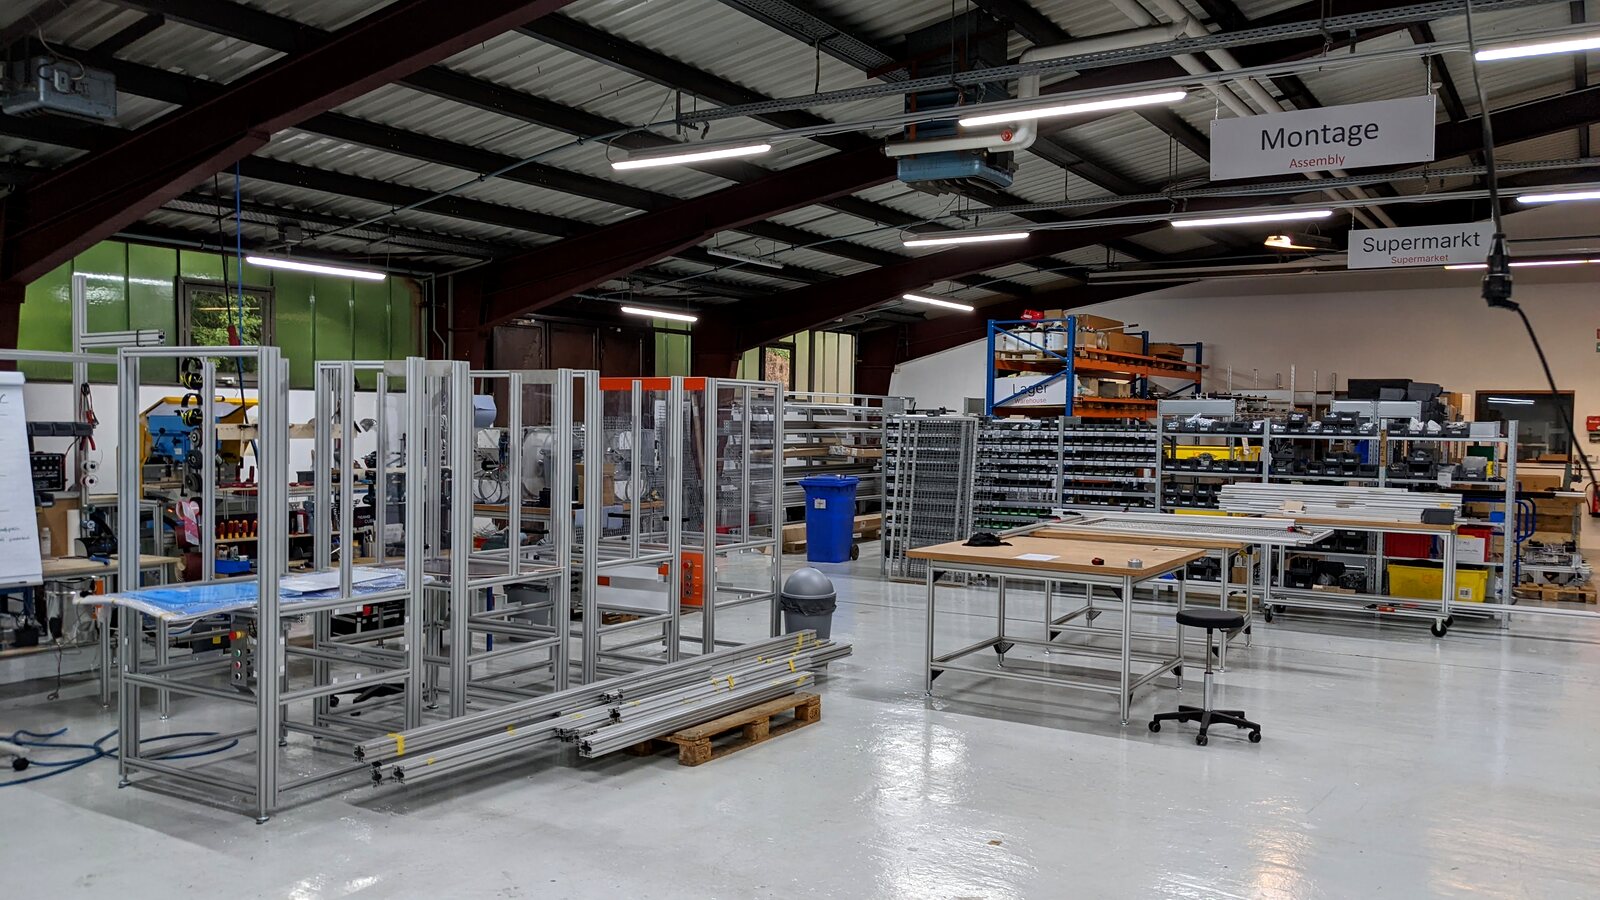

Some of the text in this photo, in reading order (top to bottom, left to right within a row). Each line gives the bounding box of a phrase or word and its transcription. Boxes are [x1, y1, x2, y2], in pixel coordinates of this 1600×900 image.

[1261, 123, 1379, 150] Montage
[1289, 154, 1346, 168] Assembly
[1362, 232, 1480, 255] Supermarkt
[1391, 254, 1449, 264] Supermarket
